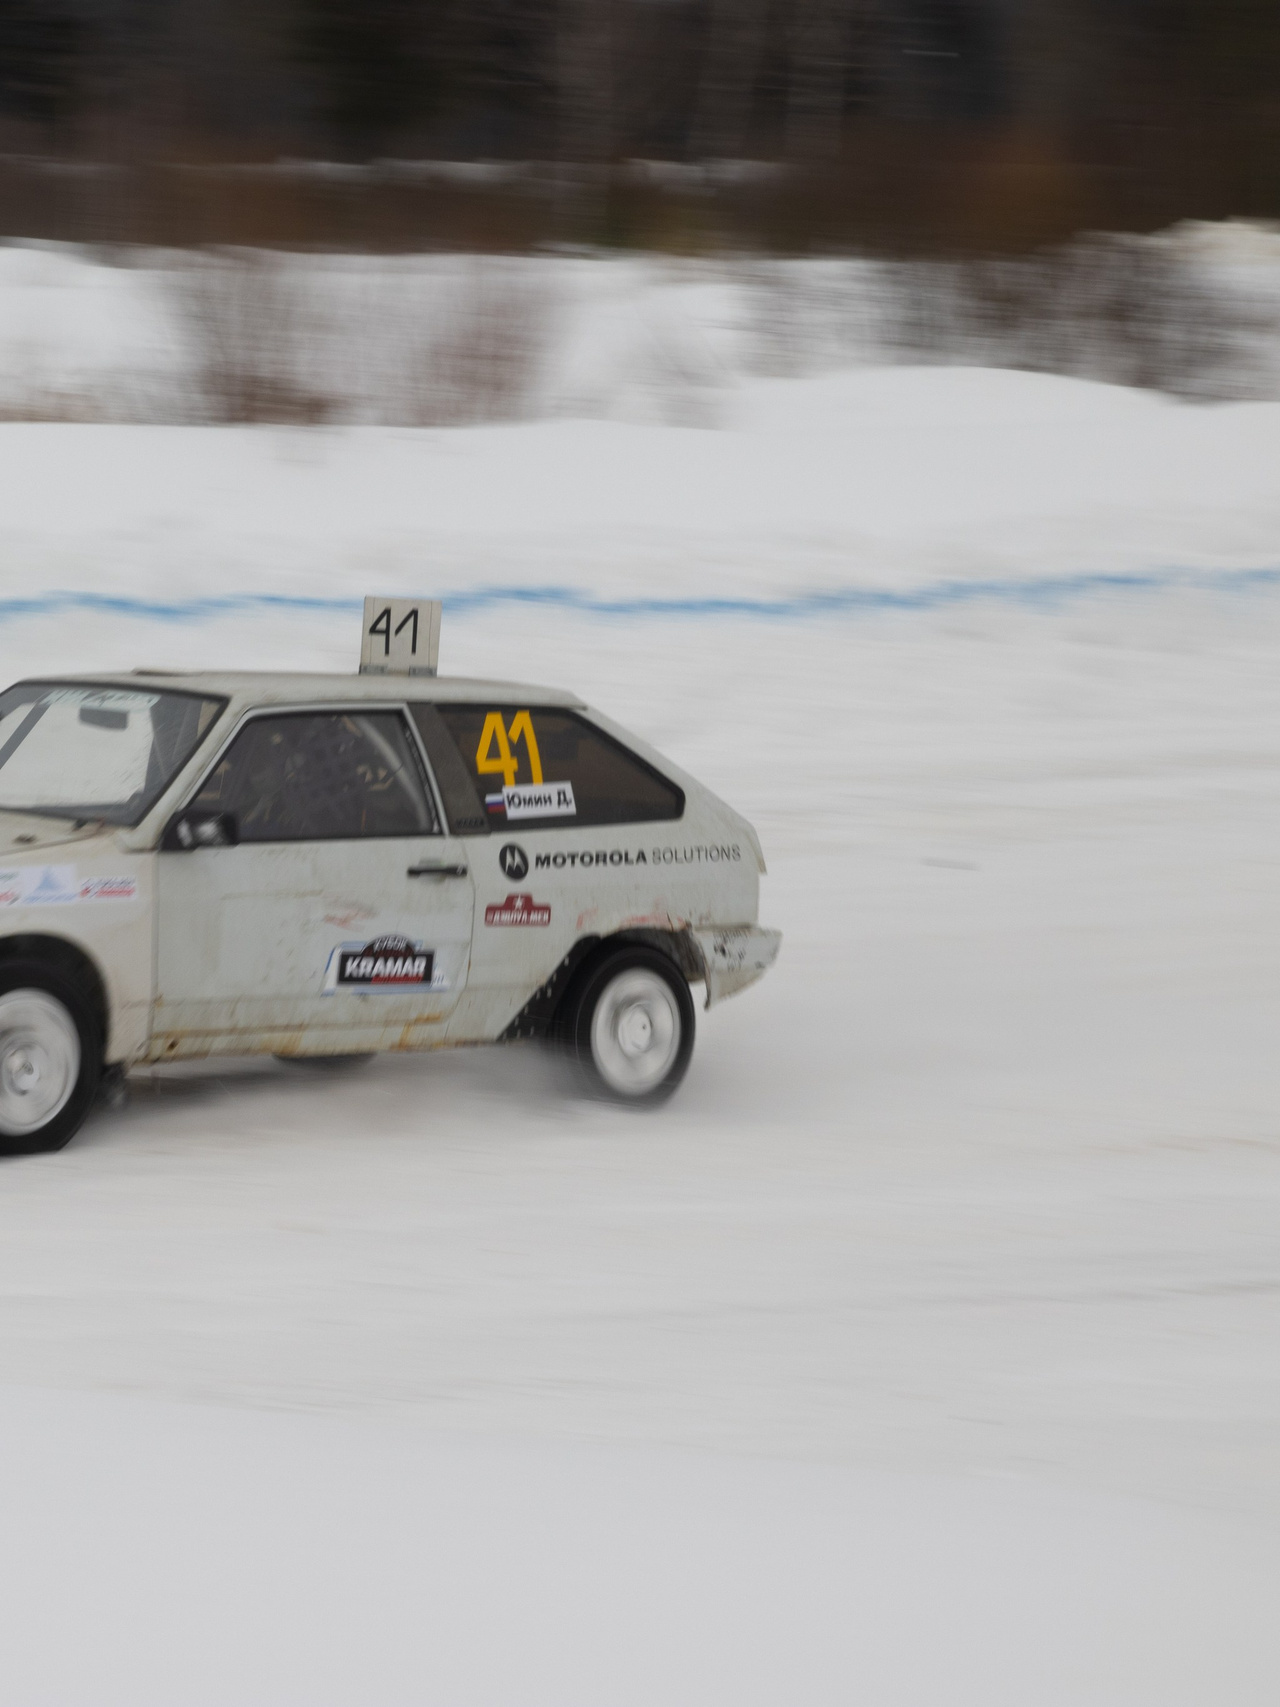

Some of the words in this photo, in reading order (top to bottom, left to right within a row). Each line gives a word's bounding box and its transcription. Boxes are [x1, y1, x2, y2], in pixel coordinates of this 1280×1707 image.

[368, 607, 419, 656] 41
[475, 709, 544, 788] 41
[505, 791, 553, 809] Юмин
[556, 786, 573, 809] Д.
[534, 849, 648, 869] MOTOROLA
[652, 844, 742, 865] SOLUTIONS
[343, 956, 427, 979] KRAMAR
